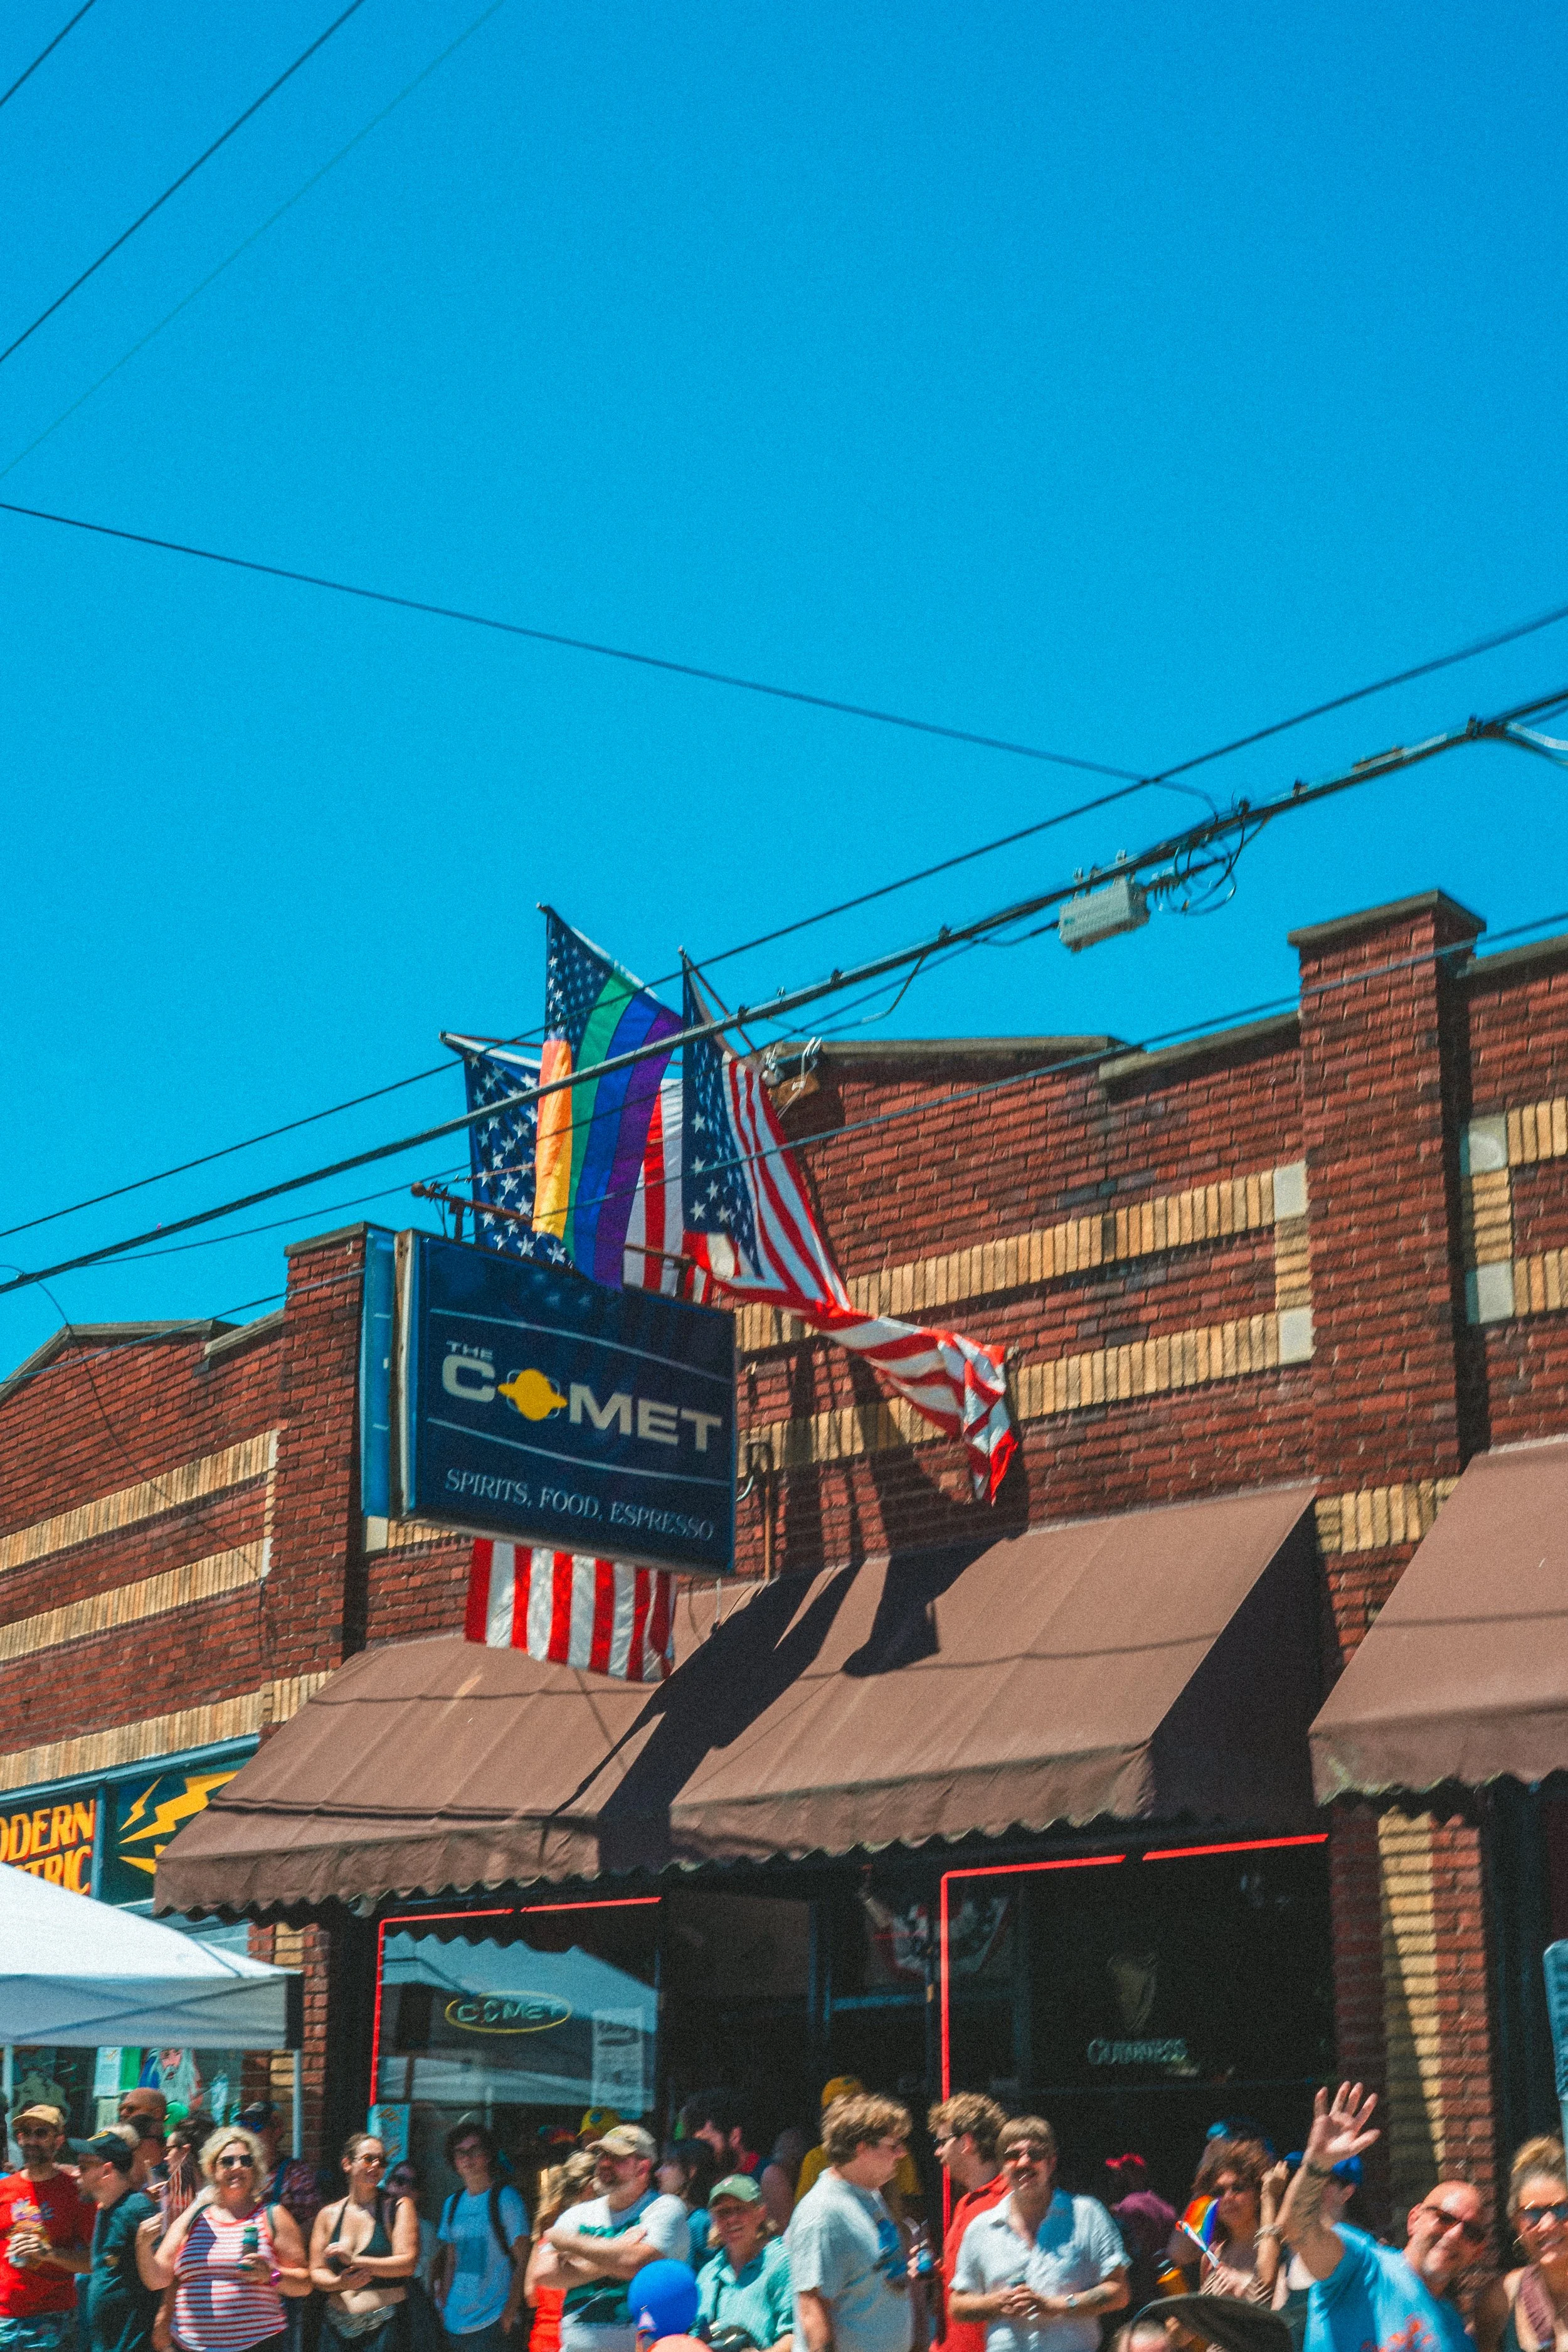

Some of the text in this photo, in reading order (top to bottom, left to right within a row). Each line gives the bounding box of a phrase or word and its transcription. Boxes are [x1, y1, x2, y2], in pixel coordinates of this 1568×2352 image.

[446, 1340, 493, 1361] THE
[442, 1355, 722, 1453] COMET
[445, 1468, 714, 1541] SPIRITS, FOOD, ESPRESSO
[14, 1845, 92, 1895] TRIC
